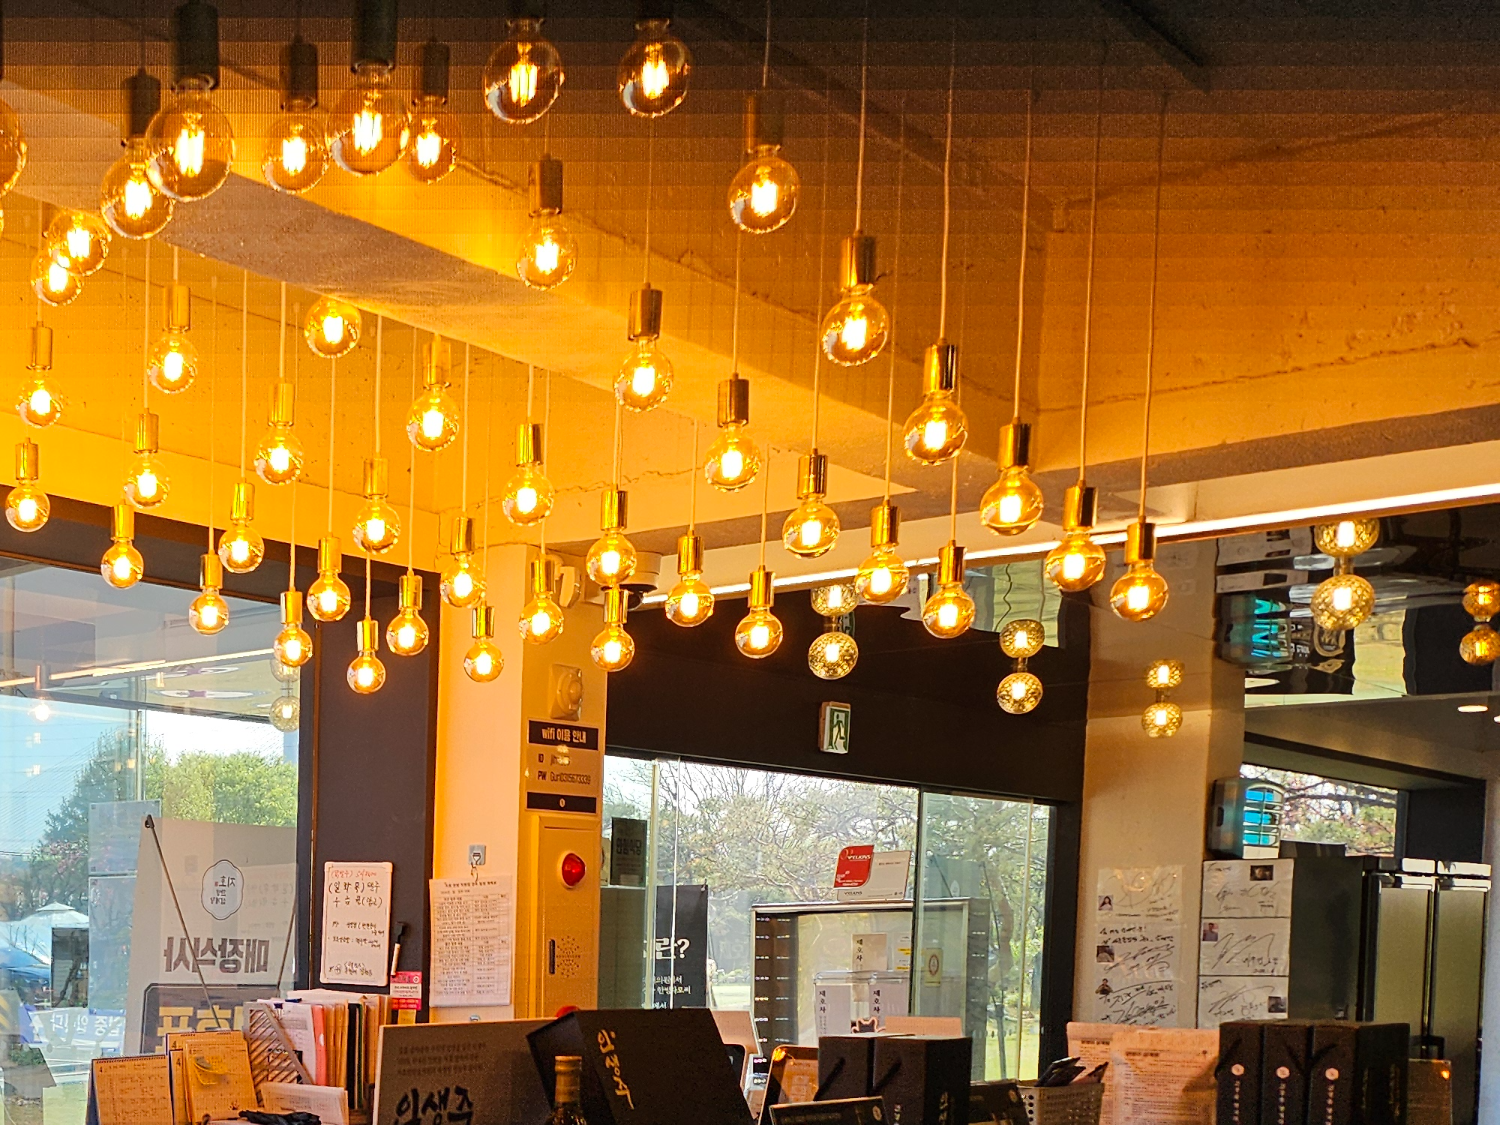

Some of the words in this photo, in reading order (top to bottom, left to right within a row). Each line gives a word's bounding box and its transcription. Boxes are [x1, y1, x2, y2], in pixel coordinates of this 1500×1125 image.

[541, 727, 555, 740] wifi
[556, 728, 570, 742] 이용
[572, 730, 587, 744] 안내
[537, 770, 547, 781] PW
[597, 1029, 635, 1110] 인생주
